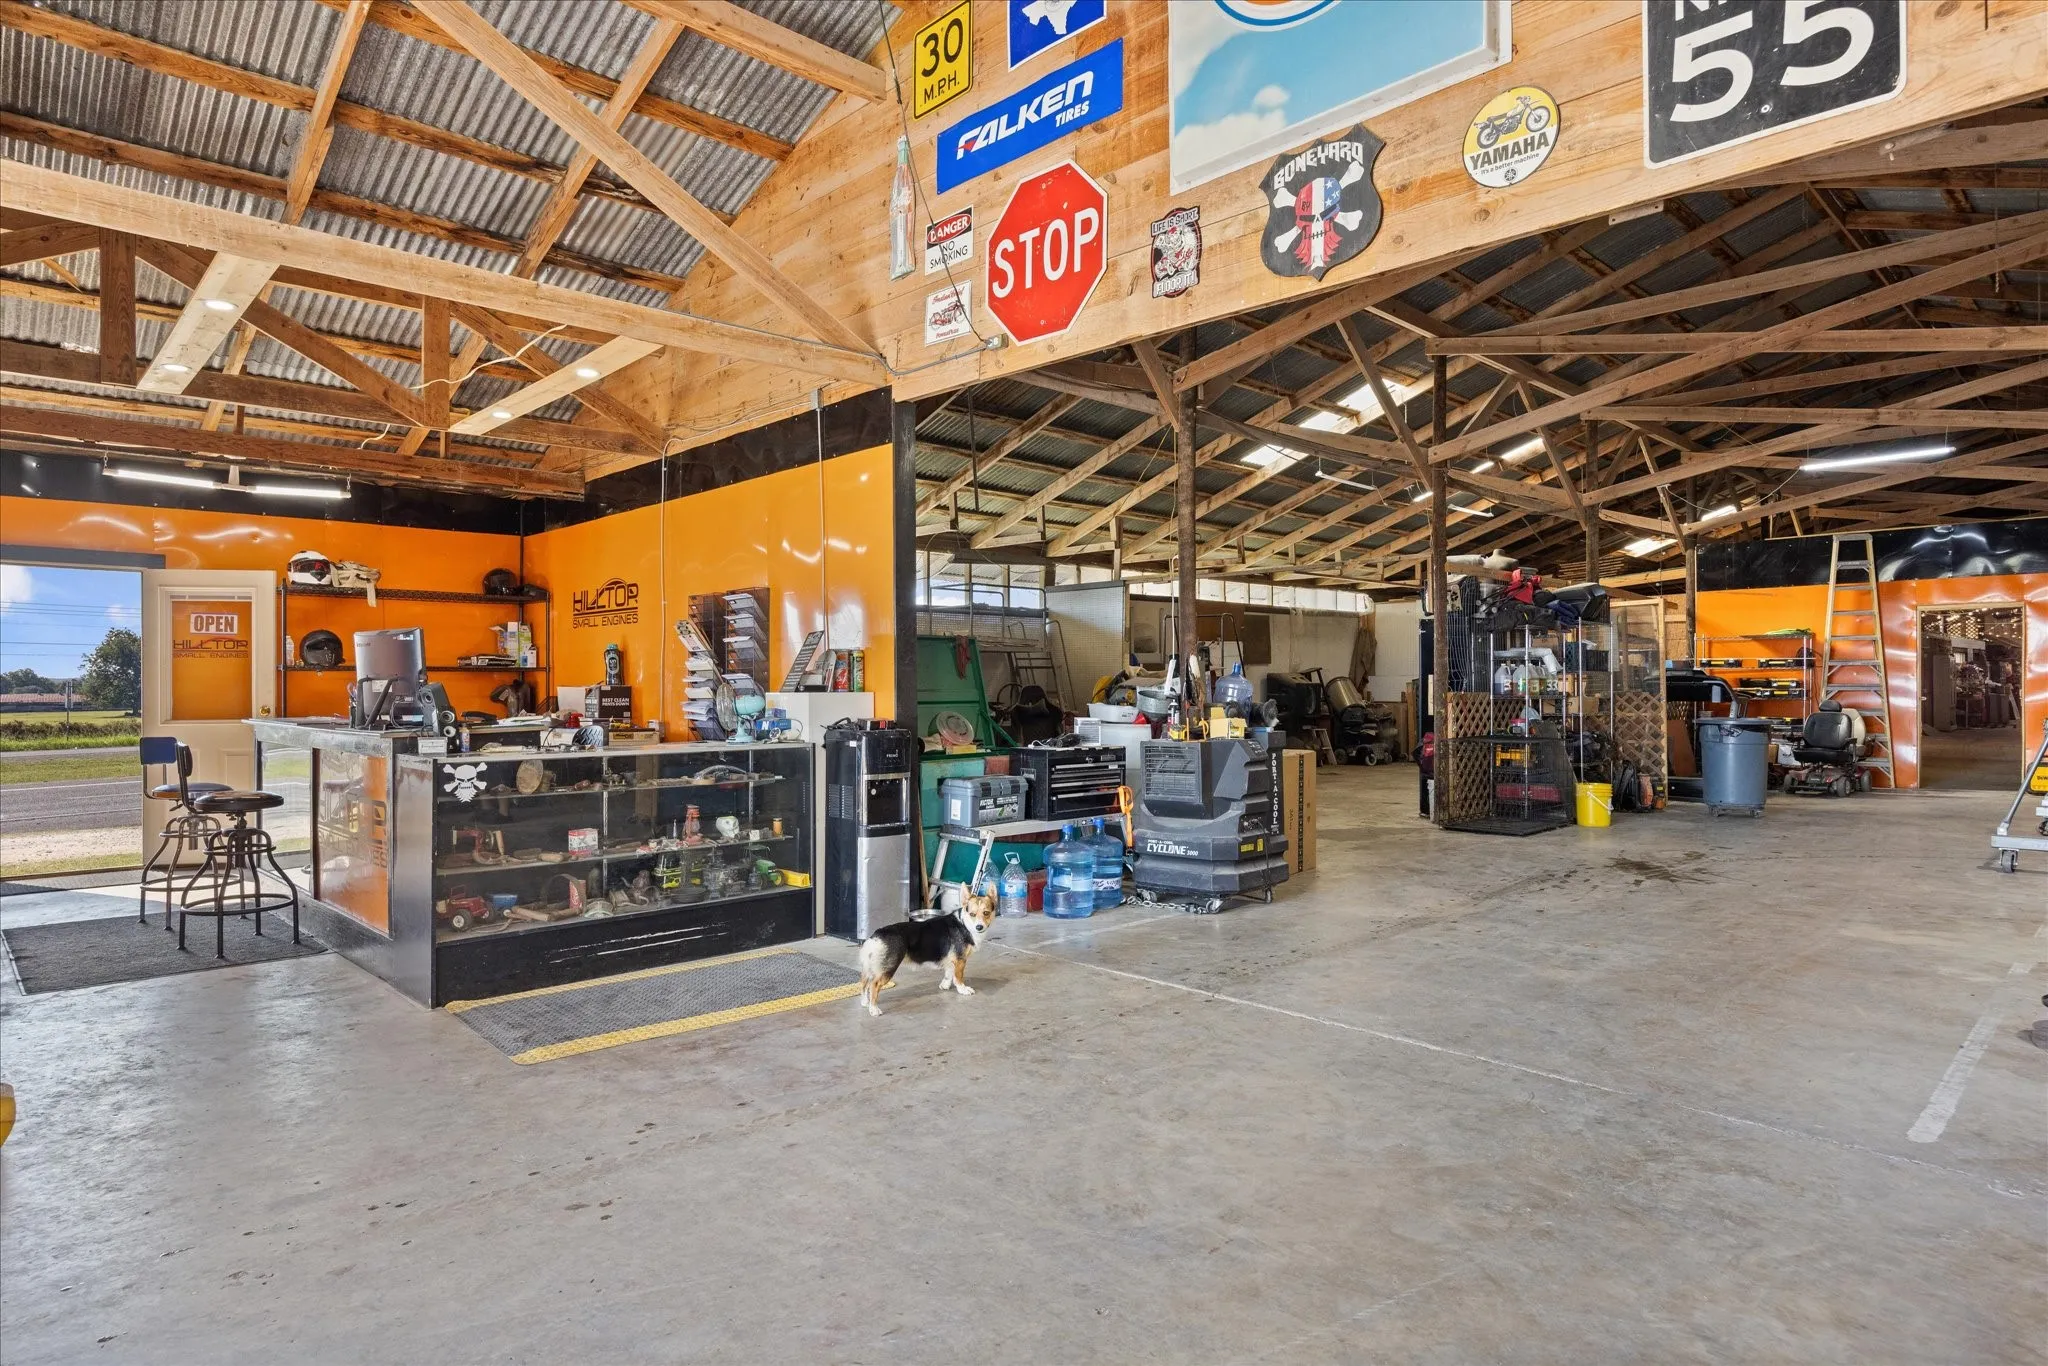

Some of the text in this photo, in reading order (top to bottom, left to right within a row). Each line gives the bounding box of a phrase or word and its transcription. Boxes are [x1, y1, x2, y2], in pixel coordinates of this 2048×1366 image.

[921, 17, 964, 77] 30
[1670, 0, 1874, 122] 55
[956, 70, 1094, 160] FALKEN
[1055, 100, 1090, 128] TIRES
[1469, 131, 1550, 171] YAMAHA
[1494, 161, 1513, 171] better
[1513, 153, 1540, 165] machine
[1273, 141, 1363, 190] BONEYARD
[930, 216, 968, 242] DANGER
[1152, 220, 1166, 234] LIFE
[1167, 216, 1175, 228] IS
[930, 245, 968, 269] SMOKING
[942, 240, 955, 252] NO
[991, 207, 1100, 299] STOP
[573, 582, 639, 613] HILLTOP
[193, 614, 235, 633] OPEN
[572, 613, 639, 629] SMALL ENGINES
[173, 639, 249, 650] HILLTOP
[173, 651, 249, 659] SMALL ENGINES
[1146, 843, 1187, 856] CYCLONE
